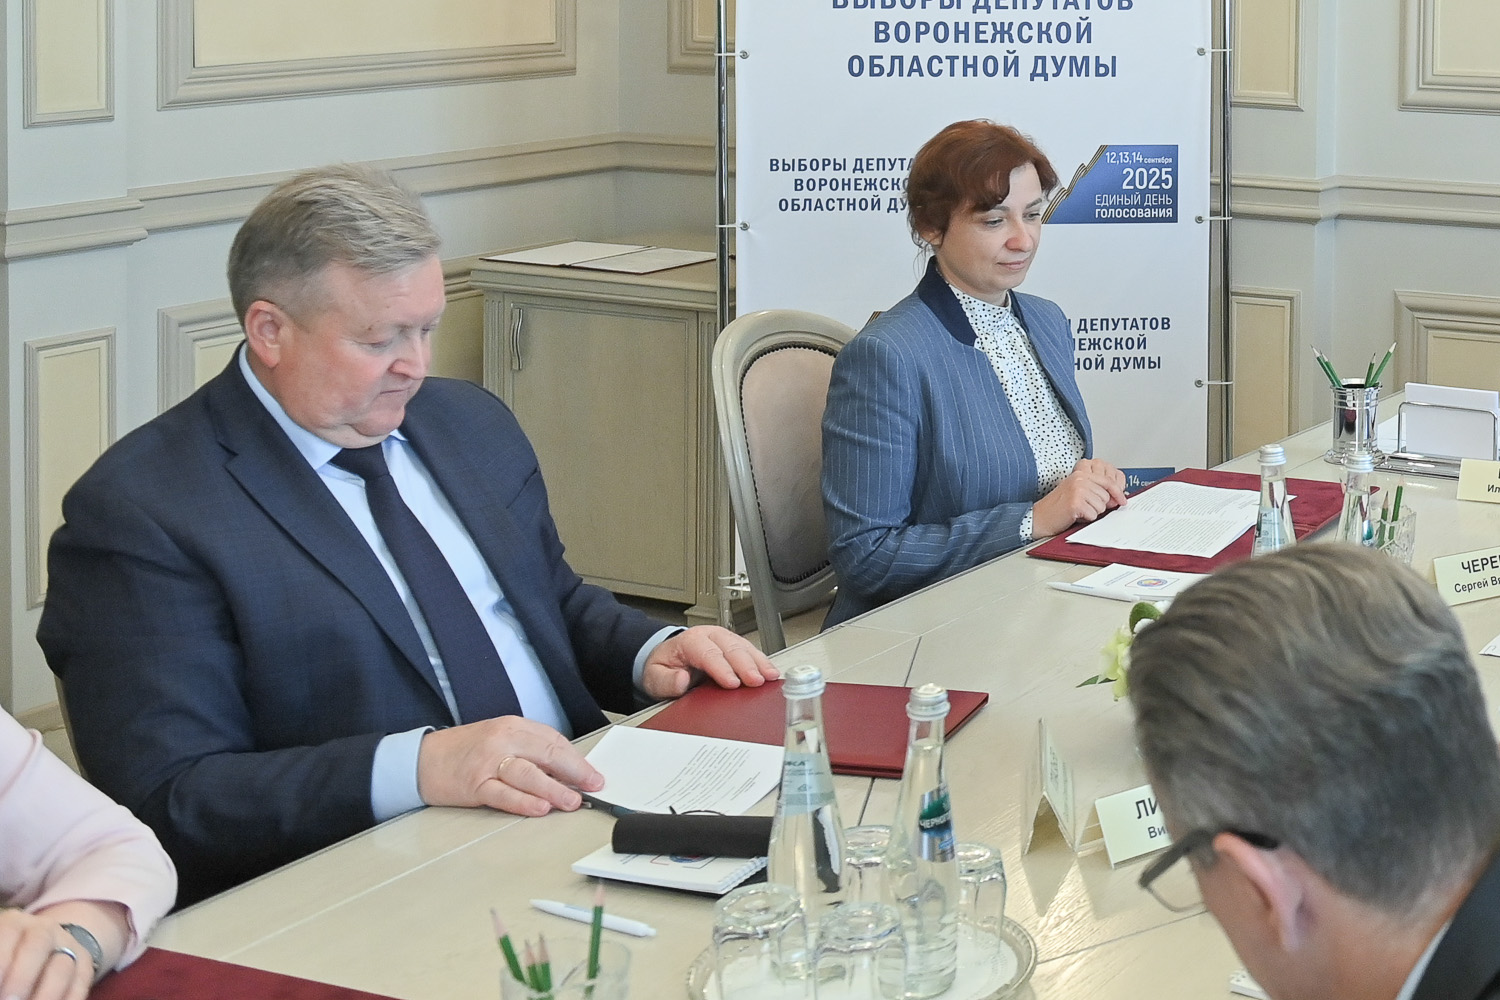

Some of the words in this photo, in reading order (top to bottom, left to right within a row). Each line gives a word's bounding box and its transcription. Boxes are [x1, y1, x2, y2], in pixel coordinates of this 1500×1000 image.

[873, 16, 1092, 44] ВОРОНЕЖСКОЙ
[847, 49, 1020, 78] ОБЛАСТНОЙ
[1029, 55, 1117, 81] ДУМЫ
[769, 157, 847, 172] ВЫБОРЫ
[1105, 151, 1143, 165] 12,13,14
[1143, 156, 1173, 164] сентября
[1122, 167, 1173, 190] 2025
[778, 194, 881, 212] ОБЛАСТНОЙ
[886, 197, 909, 213] ДУ
[1095, 191, 1141, 207] ЕДИНЫЙ
[1143, 193, 1173, 207] ДЕНЬ
[1095, 207, 1173, 219] голосования
[1077, 316, 1171, 334] ДЕПУТАТОВ
[1110, 355, 1161, 373] ДУМЫ
[1454, 578, 1489, 594] Сергей
[1135, 797, 1158, 819] ЛИ
[1147, 825, 1166, 839] Ви
